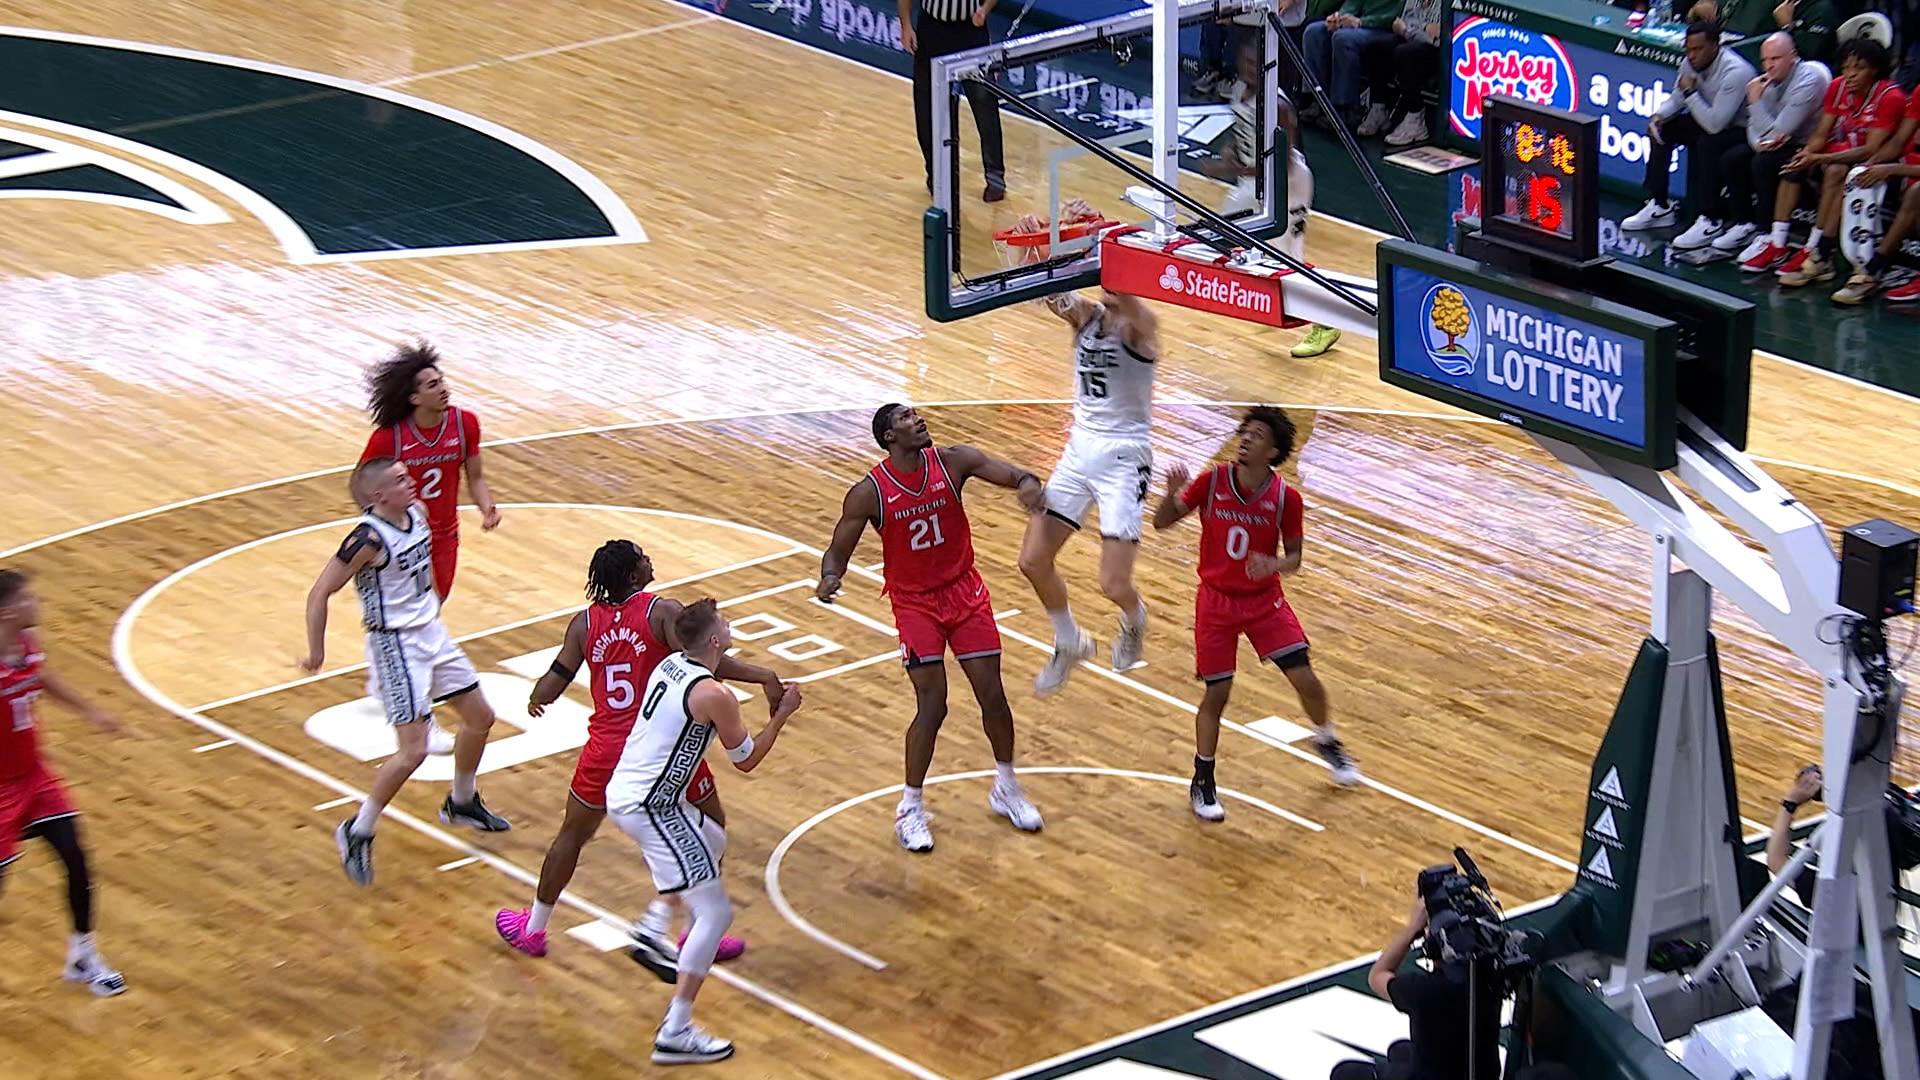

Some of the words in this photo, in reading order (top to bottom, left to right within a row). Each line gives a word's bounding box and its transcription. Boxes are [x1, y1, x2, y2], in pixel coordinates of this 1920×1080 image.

[1456, 38, 1556, 95] Jersey
[1589, 74, 1608, 107] a
[1529, 176, 1562, 231] 15
[1486, 304, 1622, 377] MICHIGAN
[1078, 371, 1107, 398] 15
[1486, 344, 1624, 422] LOTTERY
[420, 467, 442, 499] 2
[895, 497, 947, 520] RUTGERS
[908, 513, 945, 552] 21
[1226, 525, 1249, 561] 0
[592, 627, 639, 662] BUCHANAN
[605, 663, 635, 710] 5
[643, 680, 668, 721] 0
